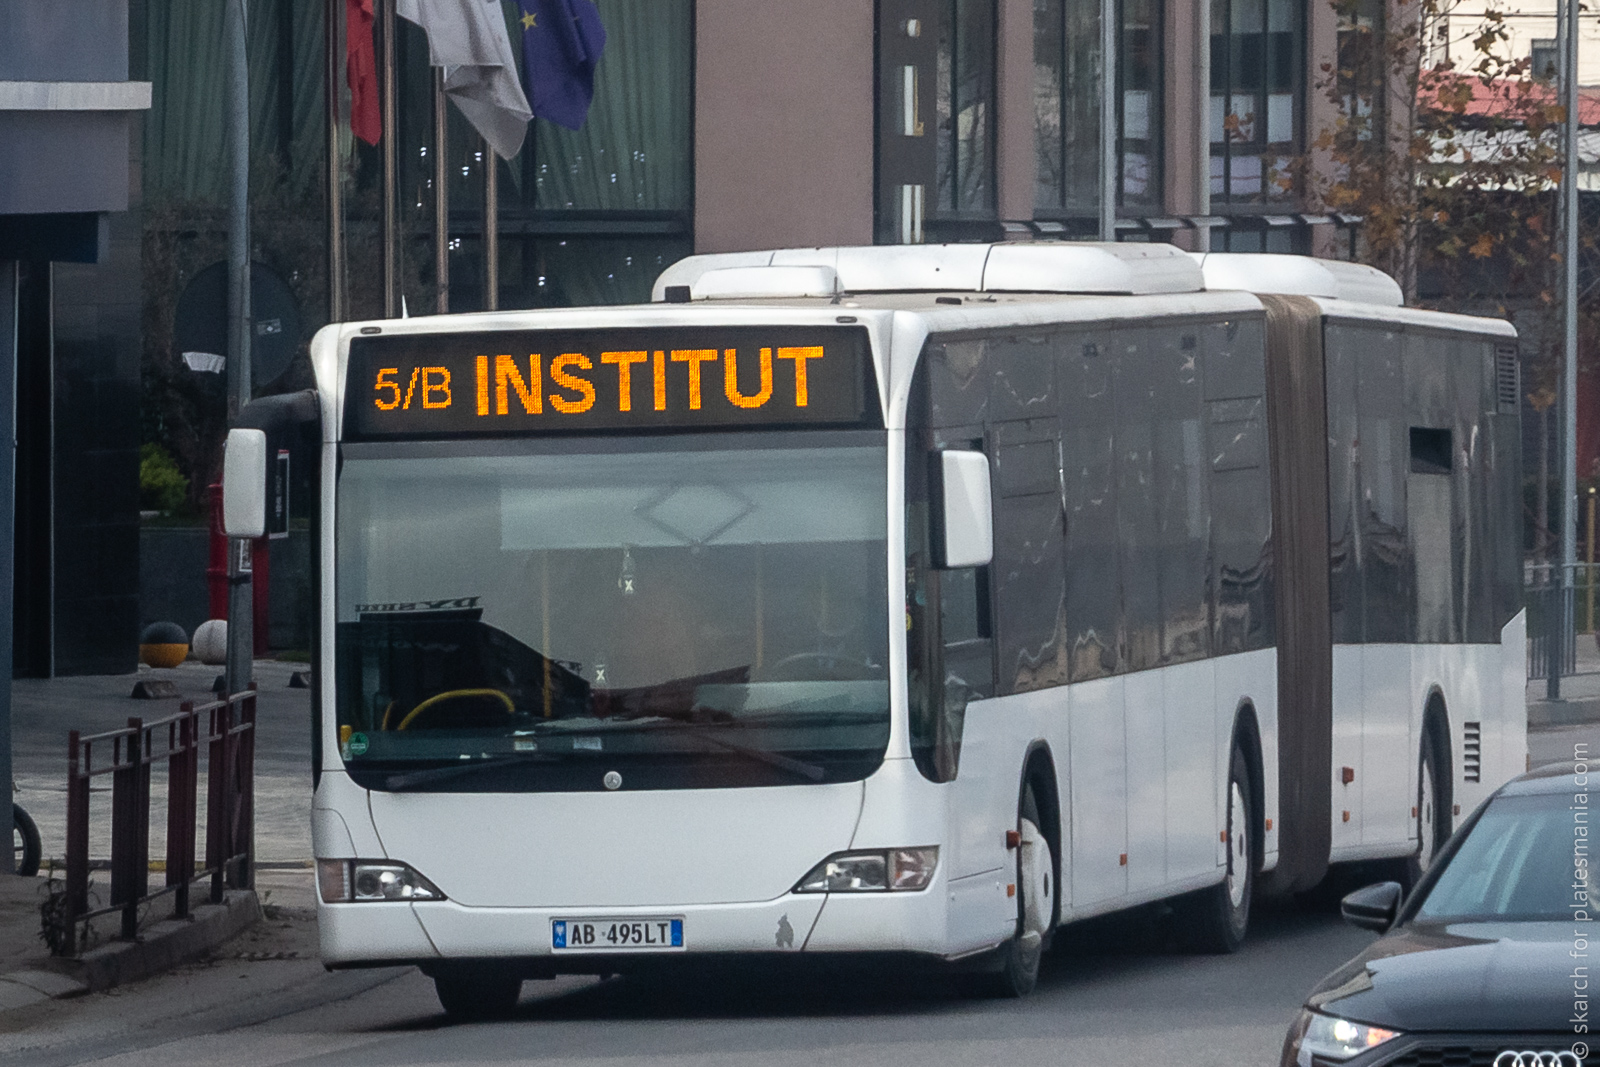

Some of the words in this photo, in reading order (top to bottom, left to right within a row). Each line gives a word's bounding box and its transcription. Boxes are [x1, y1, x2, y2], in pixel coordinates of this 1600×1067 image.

[374, 366, 452, 411] 5/B
[475, 345, 824, 416] INSTITUT
[571, 924, 595, 945] AB
[606, 923, 668, 944] 495LT
